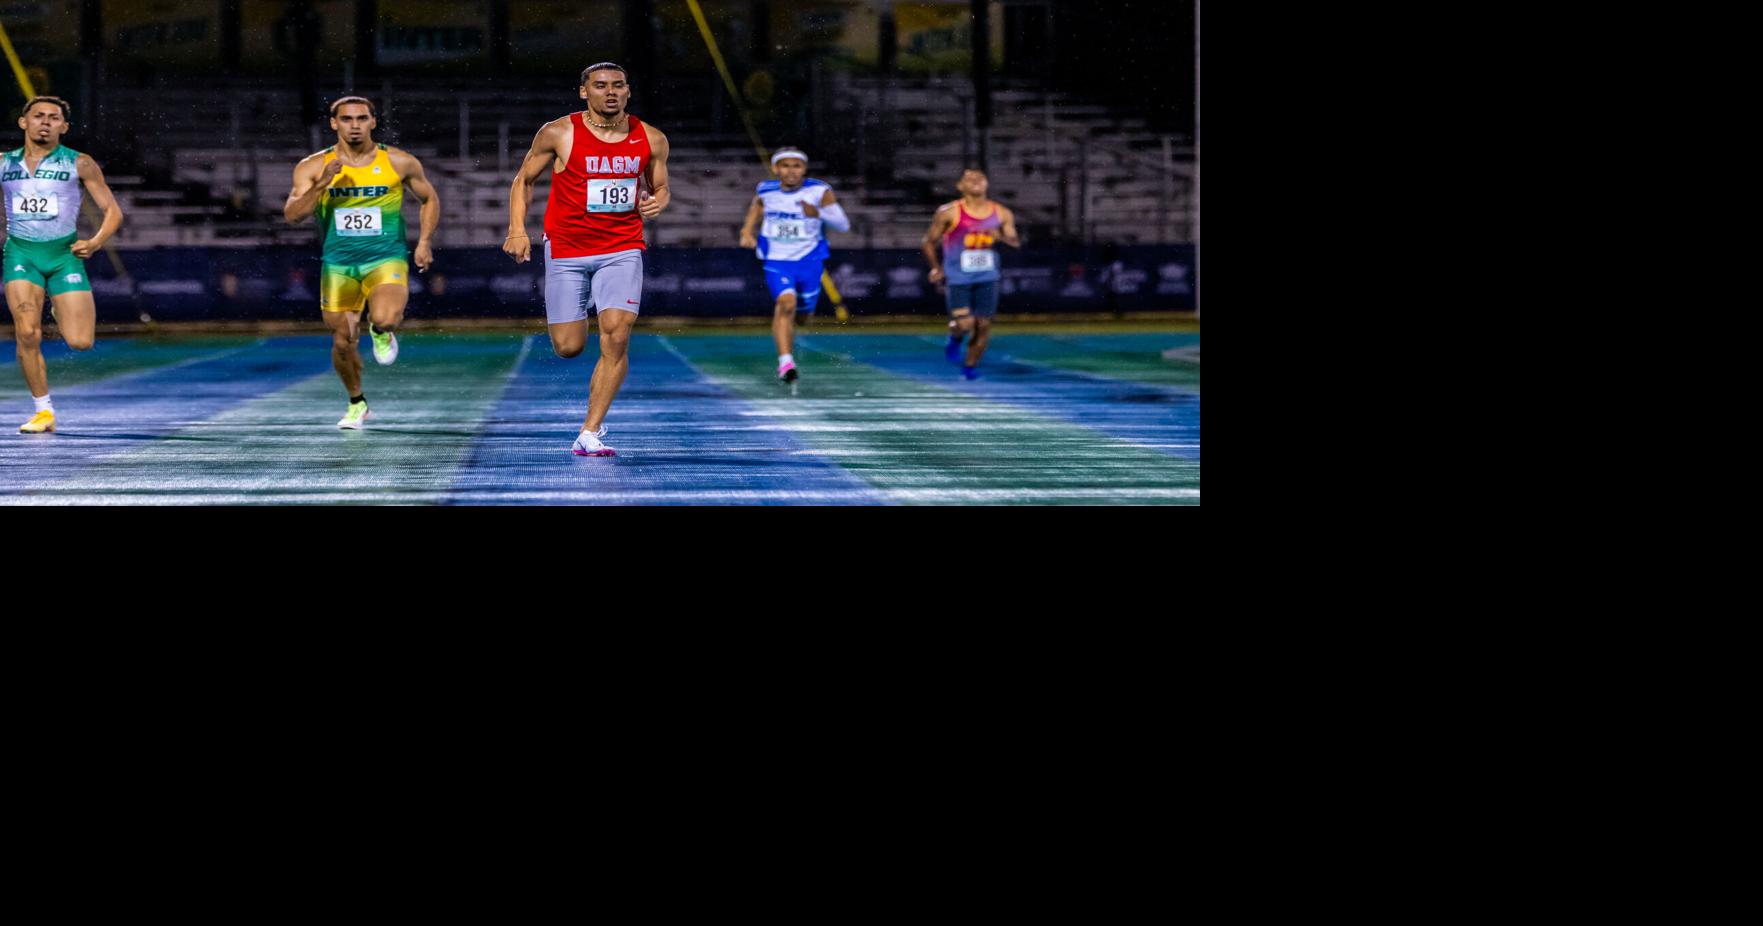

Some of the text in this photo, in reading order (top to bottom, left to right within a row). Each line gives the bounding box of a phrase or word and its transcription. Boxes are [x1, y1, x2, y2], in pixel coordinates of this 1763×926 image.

[585, 156, 641, 174] UAGM
[328, 186, 389, 197] INTER
[600, 187, 629, 204] 193
[20, 198, 48, 213] 432
[344, 215, 372, 229] 252
